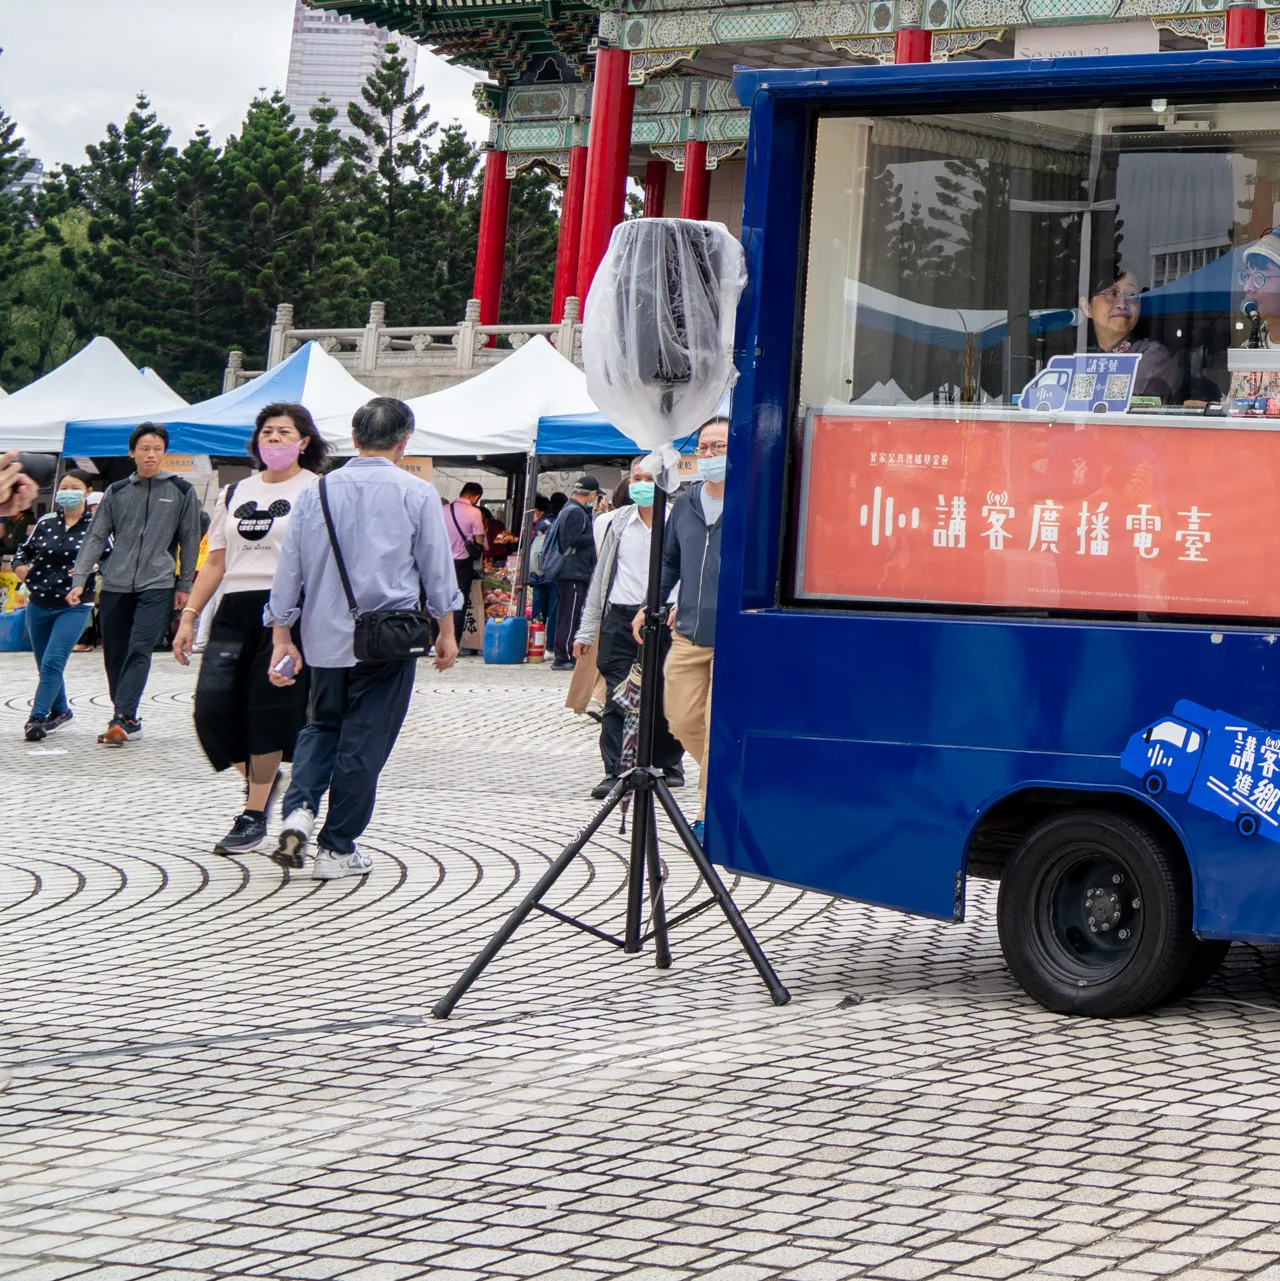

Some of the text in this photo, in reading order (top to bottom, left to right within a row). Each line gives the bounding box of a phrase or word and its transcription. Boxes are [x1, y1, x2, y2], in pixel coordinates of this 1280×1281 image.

[933, 490, 1212, 562] 講客廣播電臺
